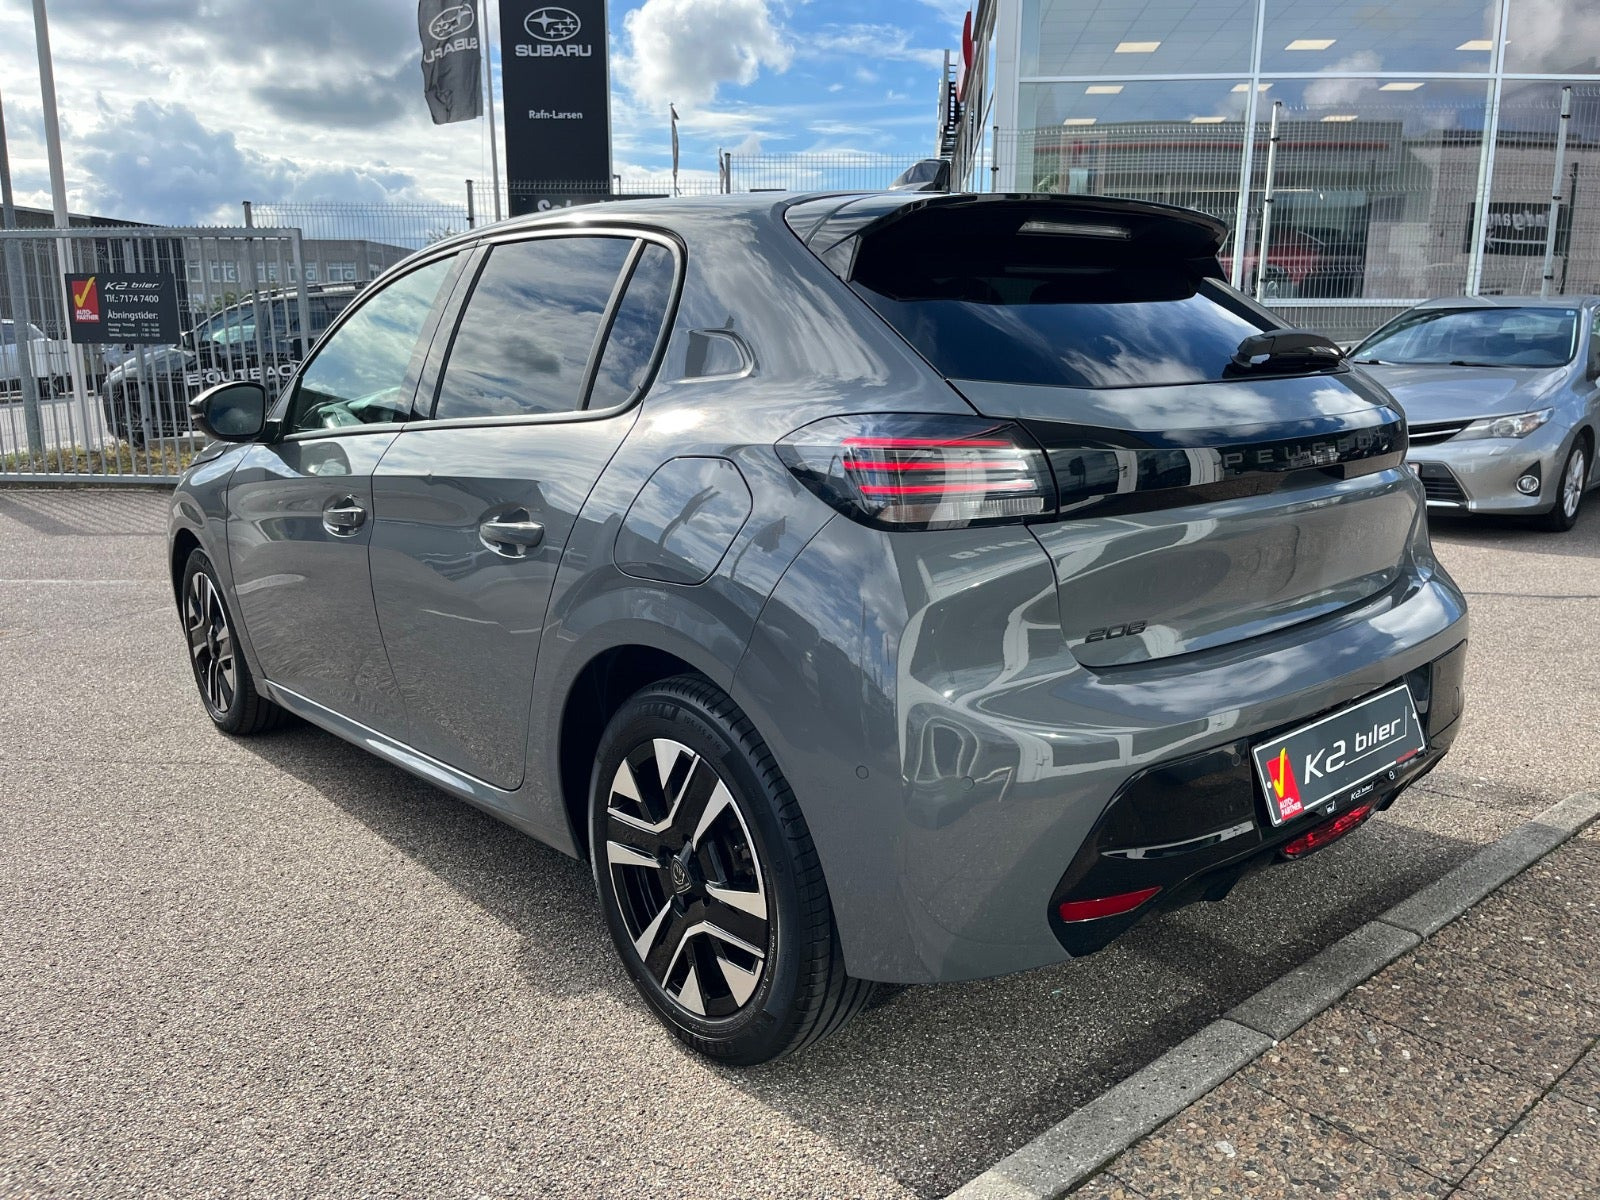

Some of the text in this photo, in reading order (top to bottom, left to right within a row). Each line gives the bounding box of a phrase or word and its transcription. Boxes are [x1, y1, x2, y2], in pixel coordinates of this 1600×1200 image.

[514, 44, 592, 57] SUBARU
[528, 109, 583, 120] Rafn-Larsen
[104, 281, 128, 291] K2
[119, 294, 139, 303] 7174
[140, 294, 160, 303] 7400
[107, 308, 159, 321] Åbningstider:
[1085, 620, 1148, 644] 208
[1304, 718, 1401, 785] K2 biler
